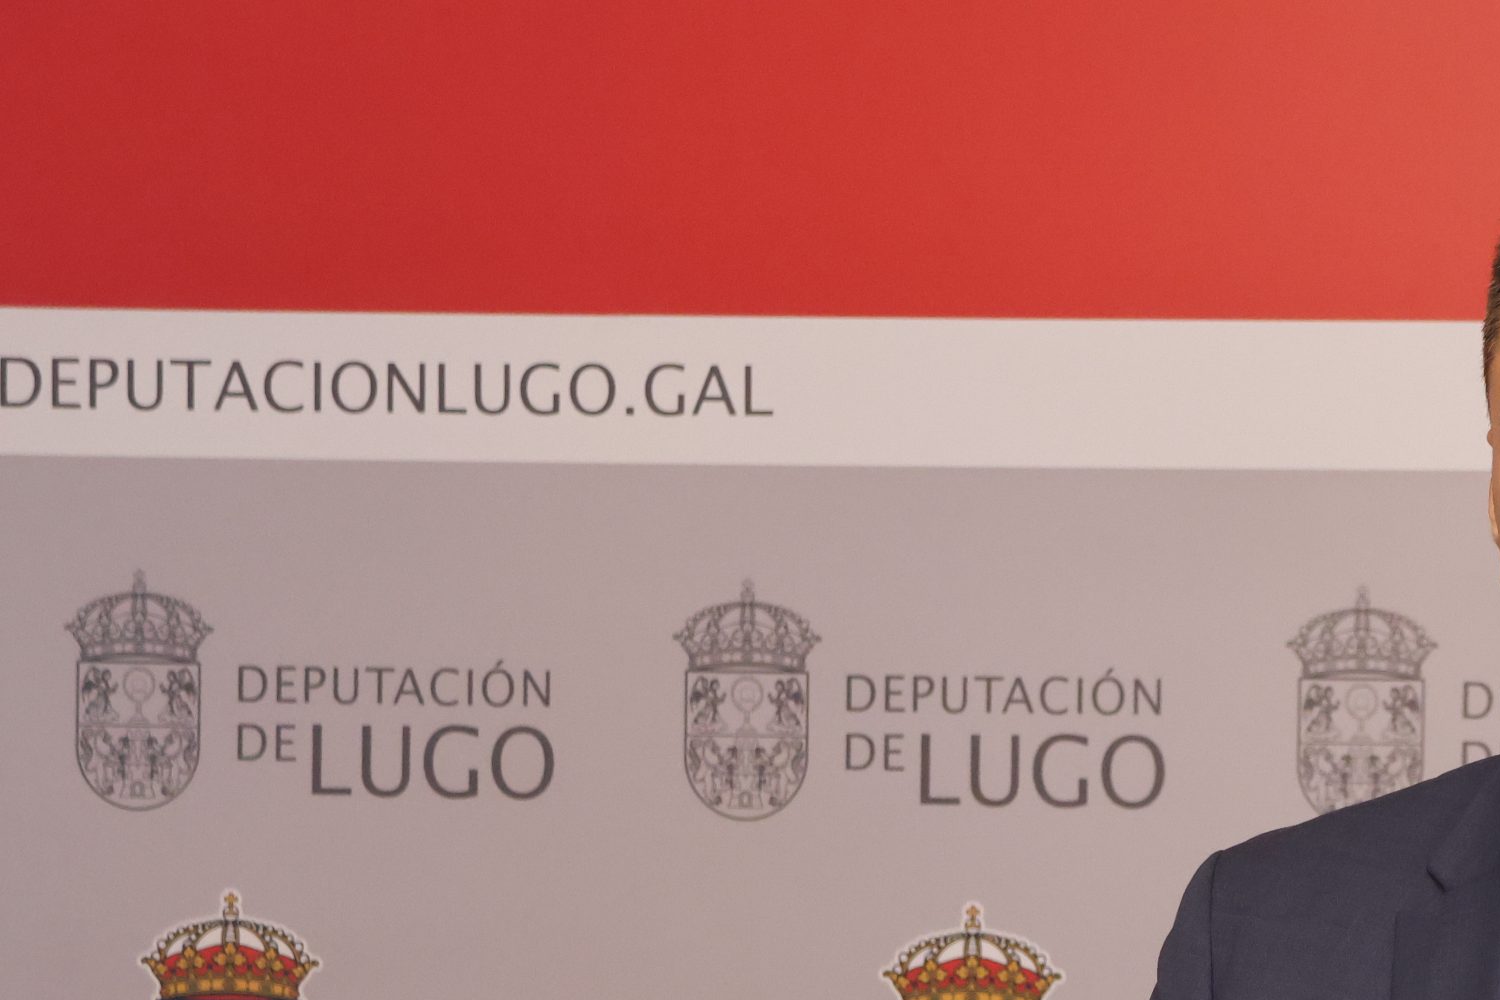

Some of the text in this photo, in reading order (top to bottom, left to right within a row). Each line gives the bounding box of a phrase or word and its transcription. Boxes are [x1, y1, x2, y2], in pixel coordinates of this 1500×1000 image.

[0, 356, 773, 417] DEPUTACIONLUGO.GAL
[237, 660, 551, 708] DEPUTACIÓN
[845, 668, 1162, 716] DEPUTACIÓN
[236, 723, 555, 800] DE LUGO
[844, 733, 1165, 810] DE LUGO
